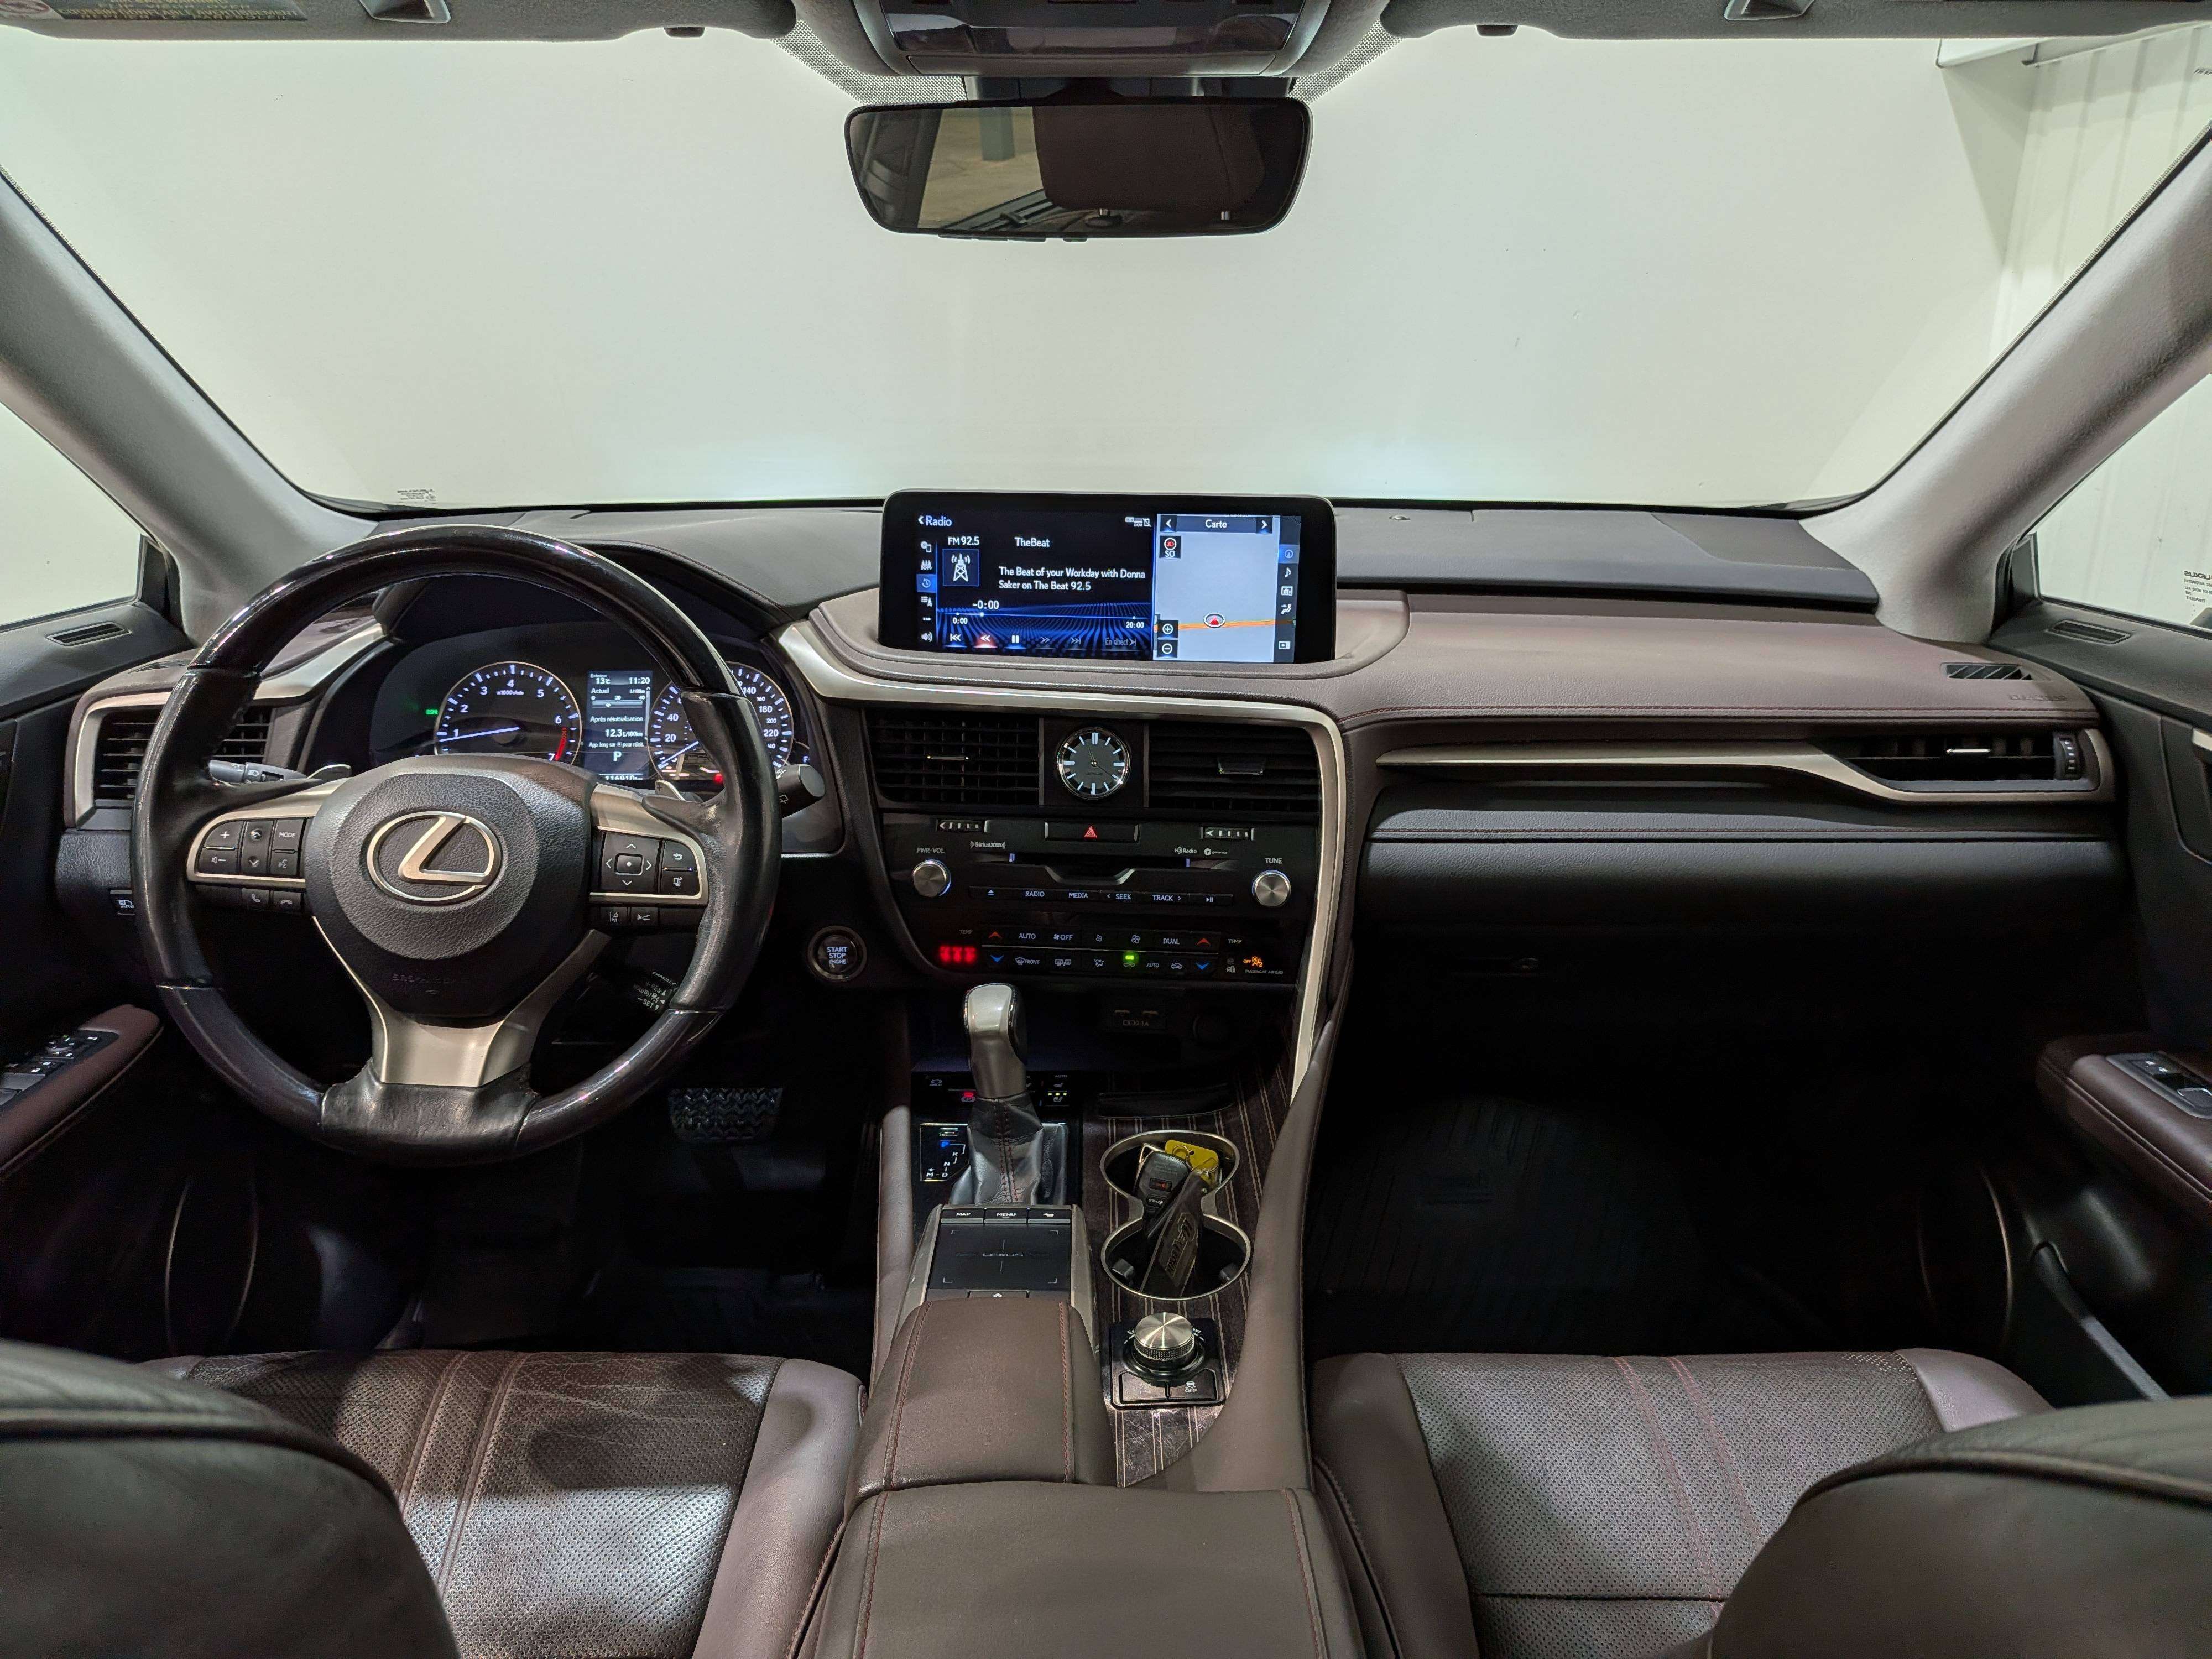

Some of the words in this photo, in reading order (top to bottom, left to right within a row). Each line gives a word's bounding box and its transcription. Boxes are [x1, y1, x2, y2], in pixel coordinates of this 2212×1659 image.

[925, 515, 952, 526] Radio
[1205, 519, 1227, 528] Carte
[947, 537, 961, 546] FM
[961, 536, 979, 546] 92.5
[999, 566, 1014, 576] The
[1016, 566, 1034, 576] Beat
[1036, 567, 1045, 576] of
[1065, 568, 1099, 579] Workday
[1101, 569, 1118, 578] with
[1120, 569, 1146, 578] Donna
[998, 580, 1020, 589] Saker
[1034, 580, 1049, 590] The
[1051, 581, 1069, 590] Beat
[1071, 581, 1091, 591] 92.5
[1105, 637, 1112, 645] En
[1113, 637, 1129, 646] direct
[507, 679, 515, 687] 4
[479, 686, 488, 695] 3
[536, 689, 545, 698] 5
[460, 704, 468, 713] 2
[555, 715, 562, 724] 6
[666, 713, 679, 722] 40
[453, 728, 460, 737] 1
[605, 729, 623, 737] 12.3
[763, 729, 779, 738] 220
[664, 734, 676, 742] 20
[547, 753, 555, 761] 7
[613, 750, 622, 762] P
[650, 984, 662, 993] RES
[643, 999, 654, 1008] SET
